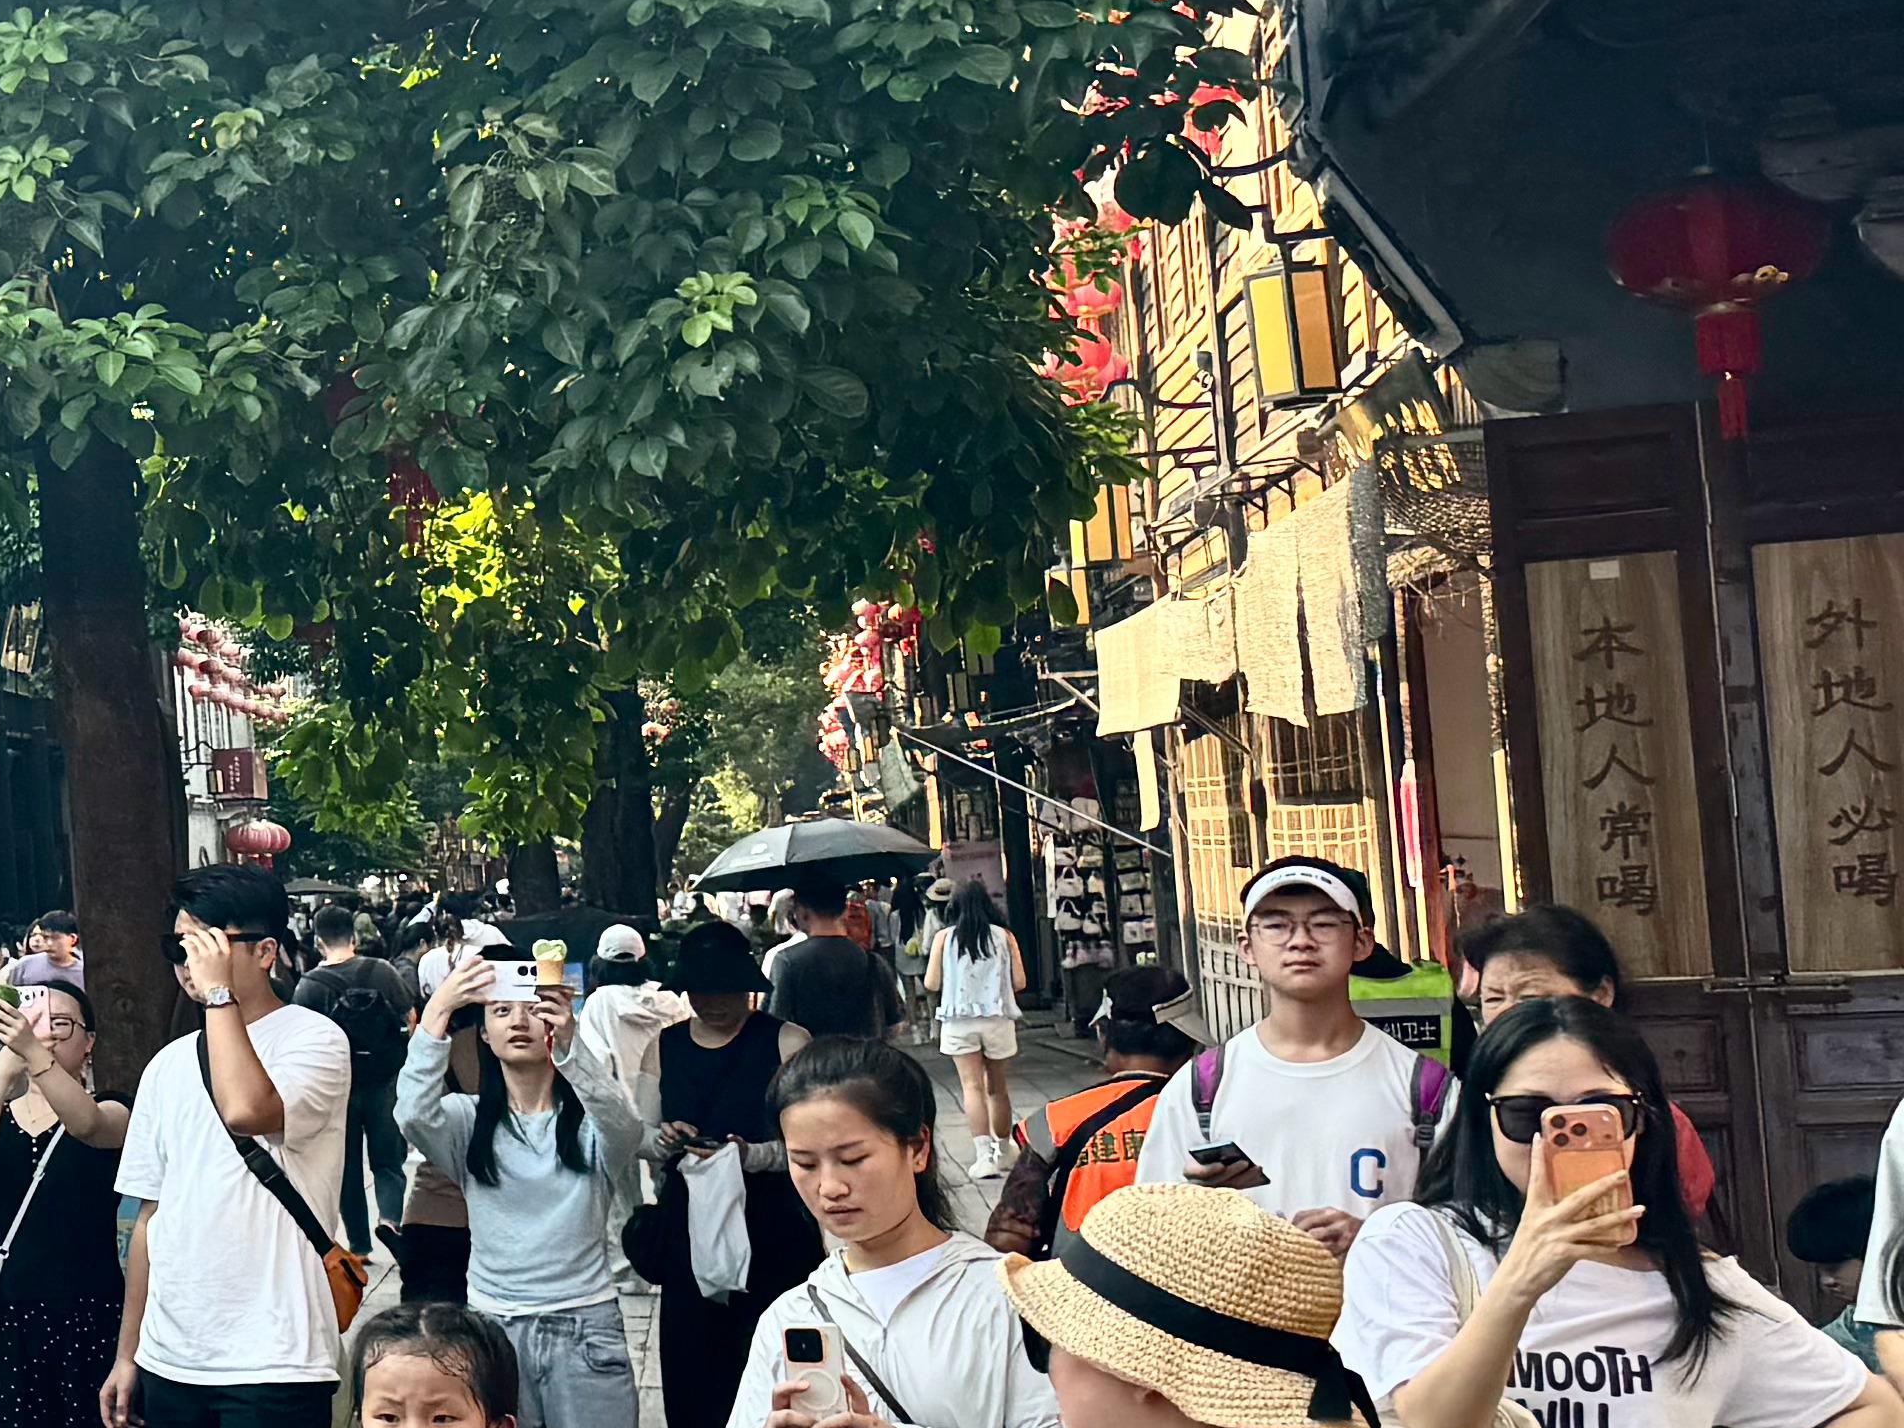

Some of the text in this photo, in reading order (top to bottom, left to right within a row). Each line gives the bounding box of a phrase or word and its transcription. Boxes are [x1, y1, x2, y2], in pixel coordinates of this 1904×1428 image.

[1572, 616, 1659, 916] 本地人常喝
[1803, 597, 1899, 907] 外地人必喝
[1350, 1147, 1386, 1199] C
[1506, 1345, 1654, 1398] MOOTH
